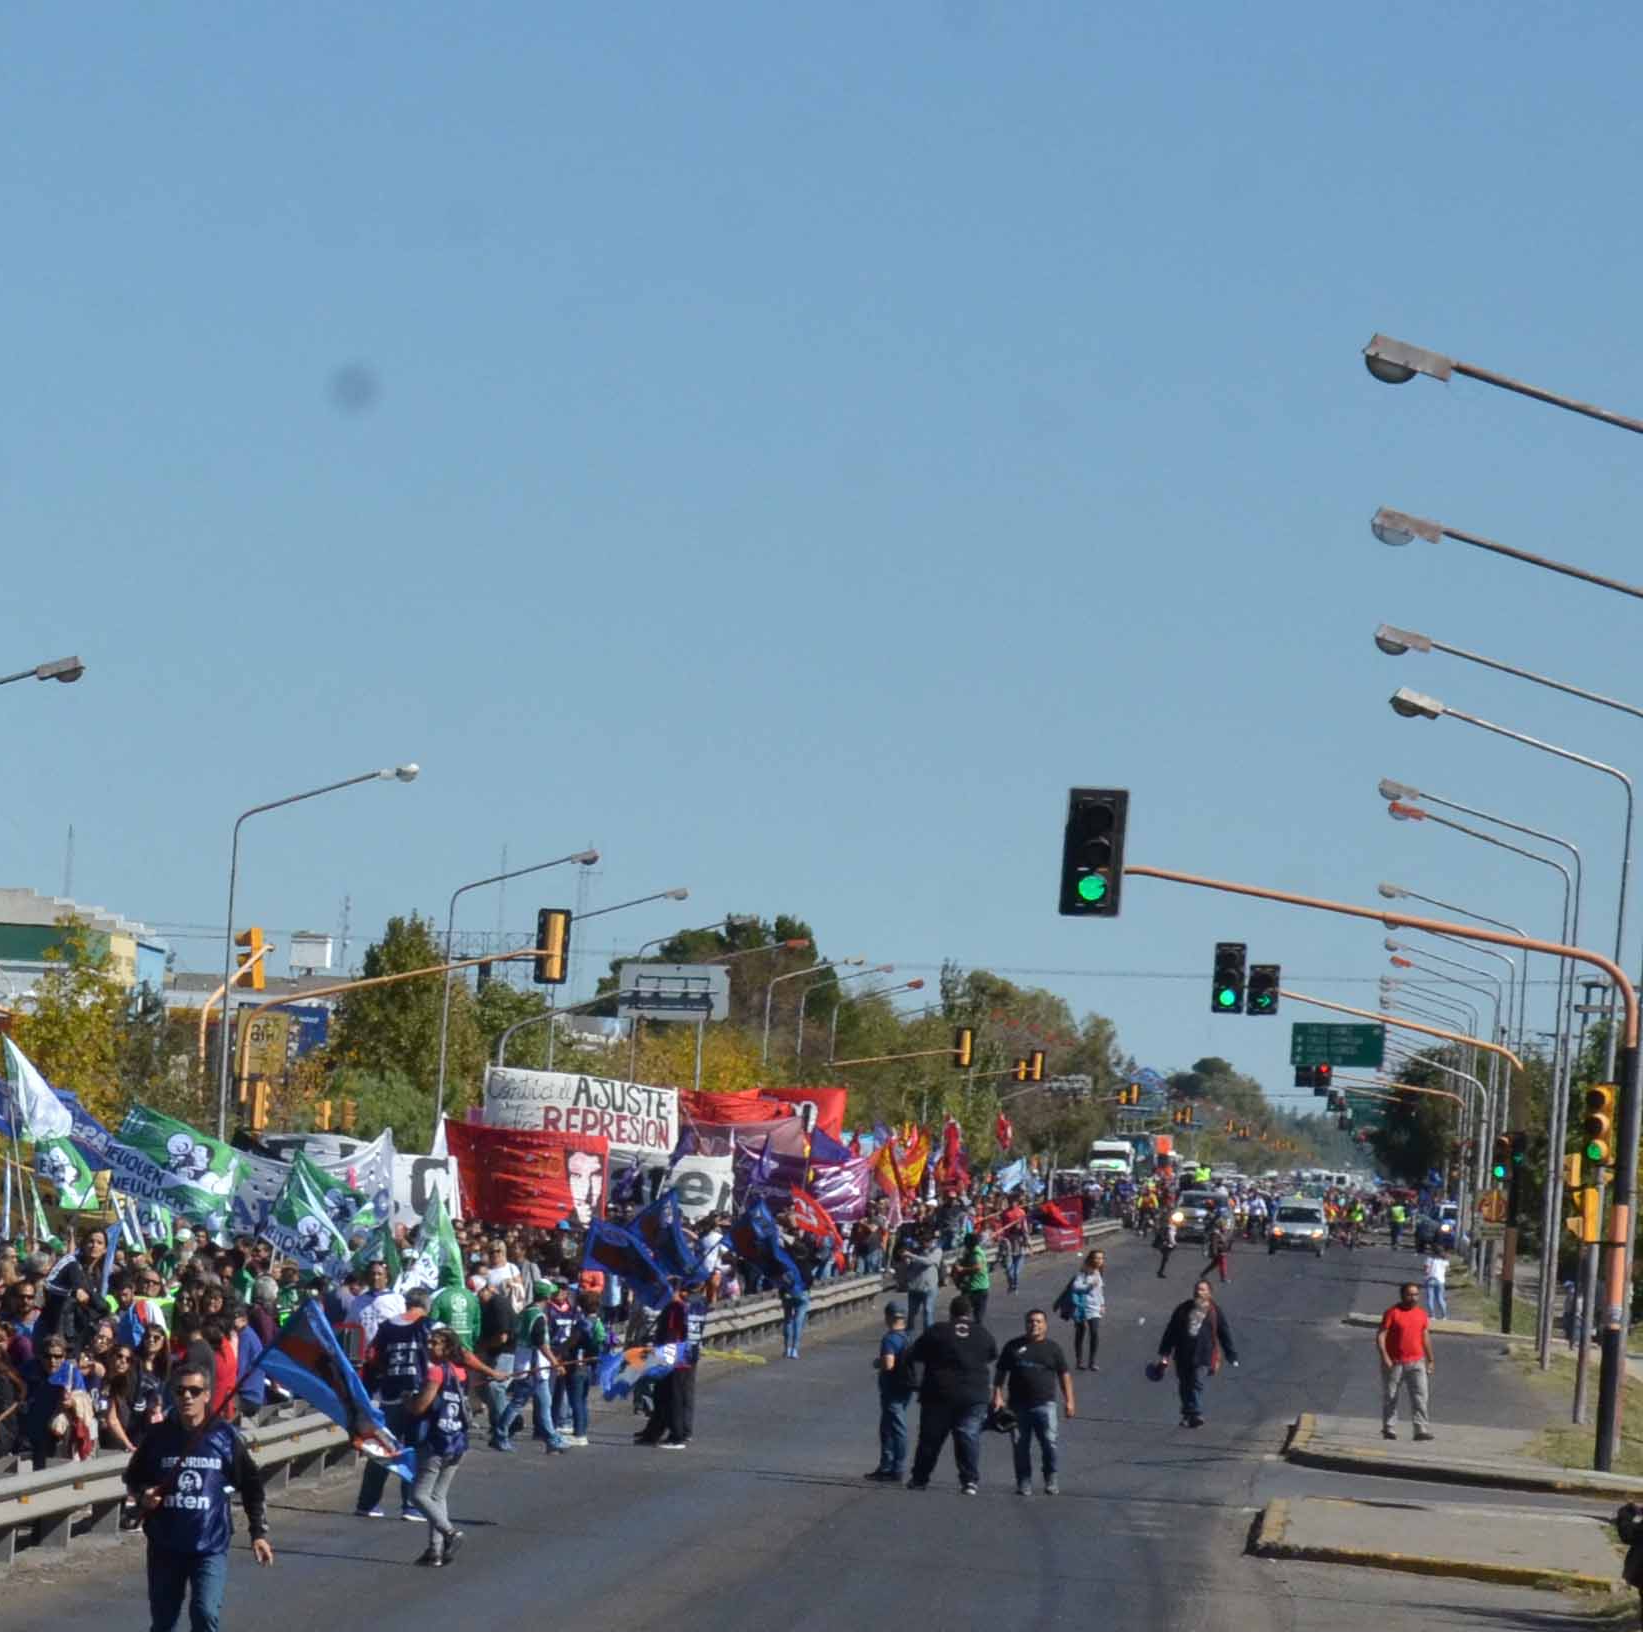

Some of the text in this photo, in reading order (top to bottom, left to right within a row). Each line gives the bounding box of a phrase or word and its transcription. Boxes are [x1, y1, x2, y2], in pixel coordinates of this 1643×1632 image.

[572, 1077, 669, 1120] AJUSTE
[543, 1106, 670, 1149] REPRESION
[163, 1491, 211, 1510] aten
